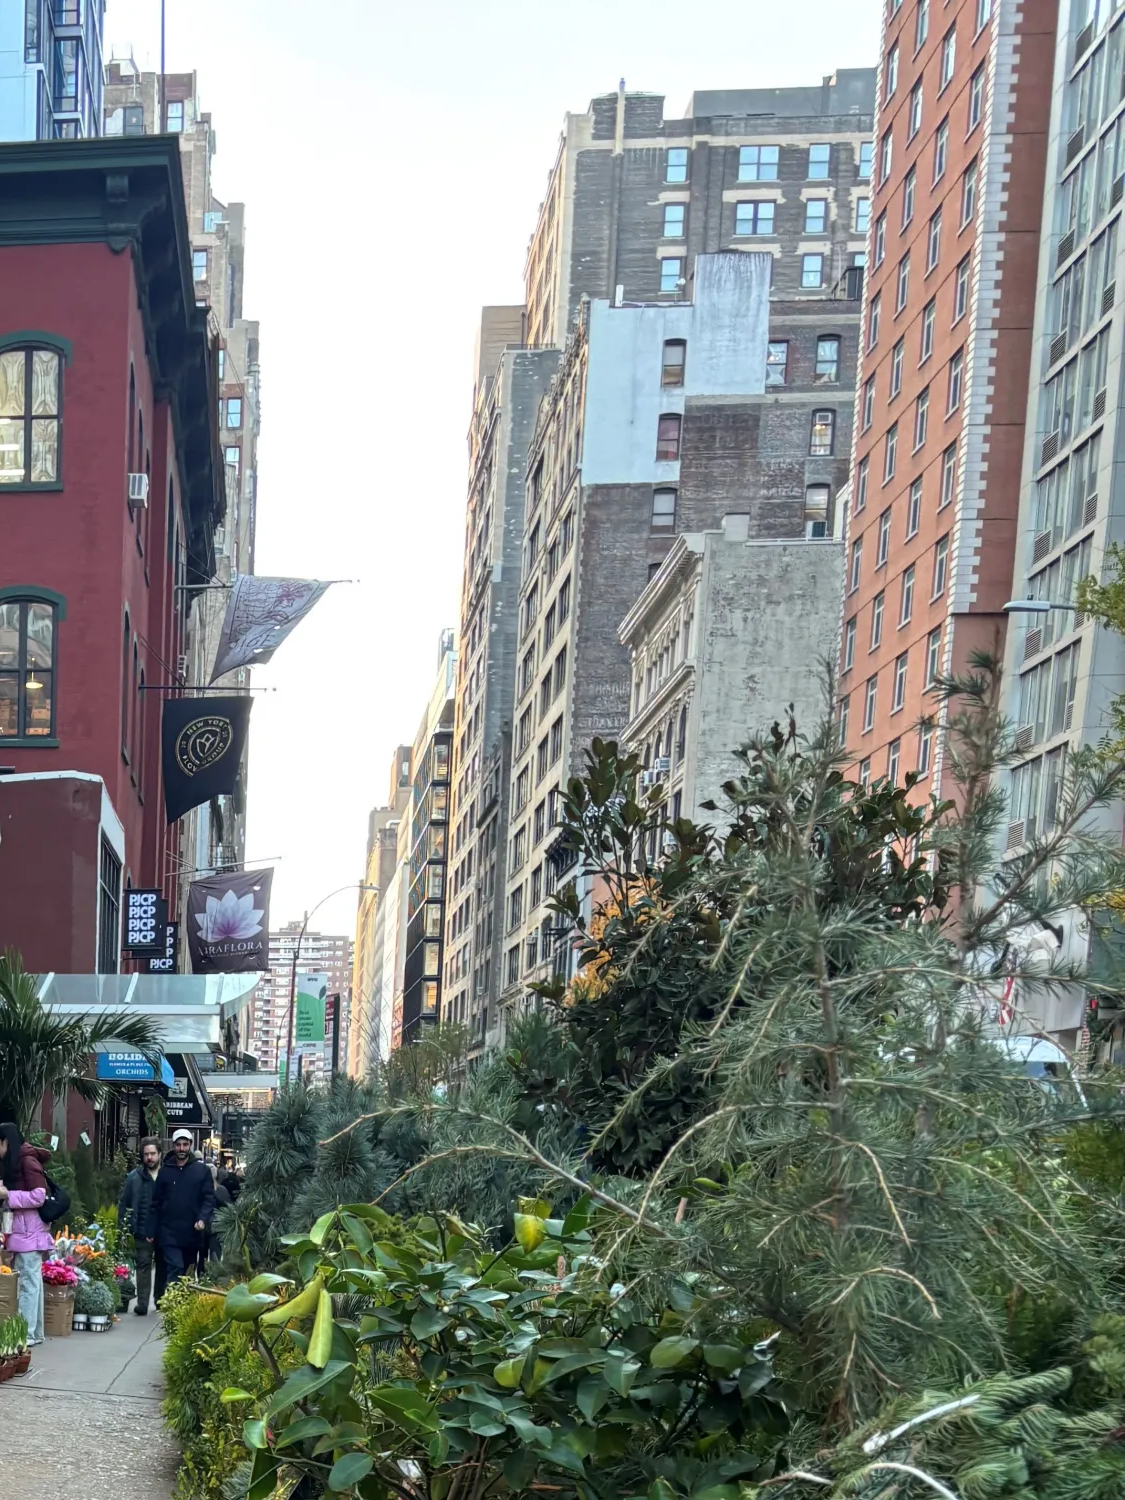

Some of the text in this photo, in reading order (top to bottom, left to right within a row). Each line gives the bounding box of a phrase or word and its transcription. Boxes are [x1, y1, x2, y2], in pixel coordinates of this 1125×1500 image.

[186, 721, 205, 735] NEW
[129, 893, 156, 906] PJCP
[129, 906, 156, 918] PJCP
[128, 918, 156, 931] PJCP
[128, 931, 156, 943] PJCP
[150, 958, 173, 970] PJCP
